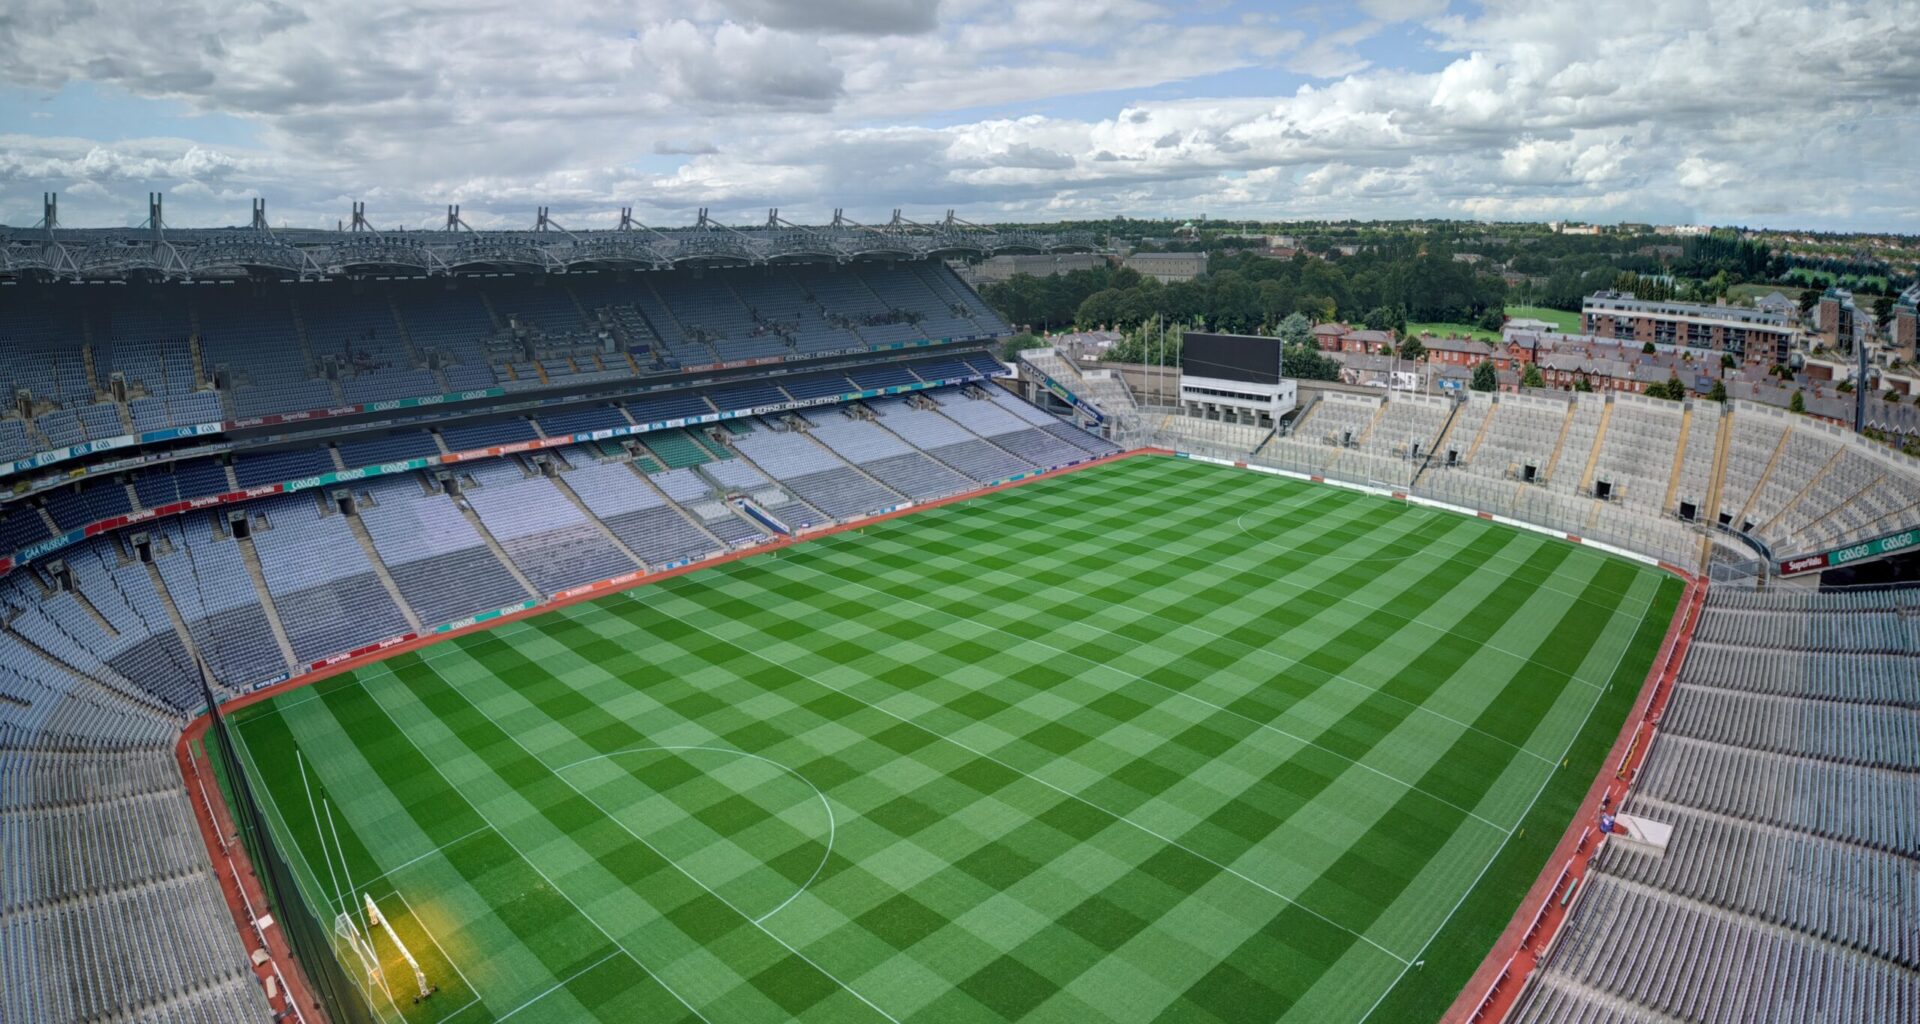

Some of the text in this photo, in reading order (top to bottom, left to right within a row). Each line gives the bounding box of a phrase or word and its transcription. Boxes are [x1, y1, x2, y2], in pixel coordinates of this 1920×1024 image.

[25, 535, 70, 559] GAA MUSEUM
[1881, 532, 1913, 551] GAAGO
[1838, 544, 1870, 562] GAAGO
[1788, 556, 1822, 572] SuperValu
